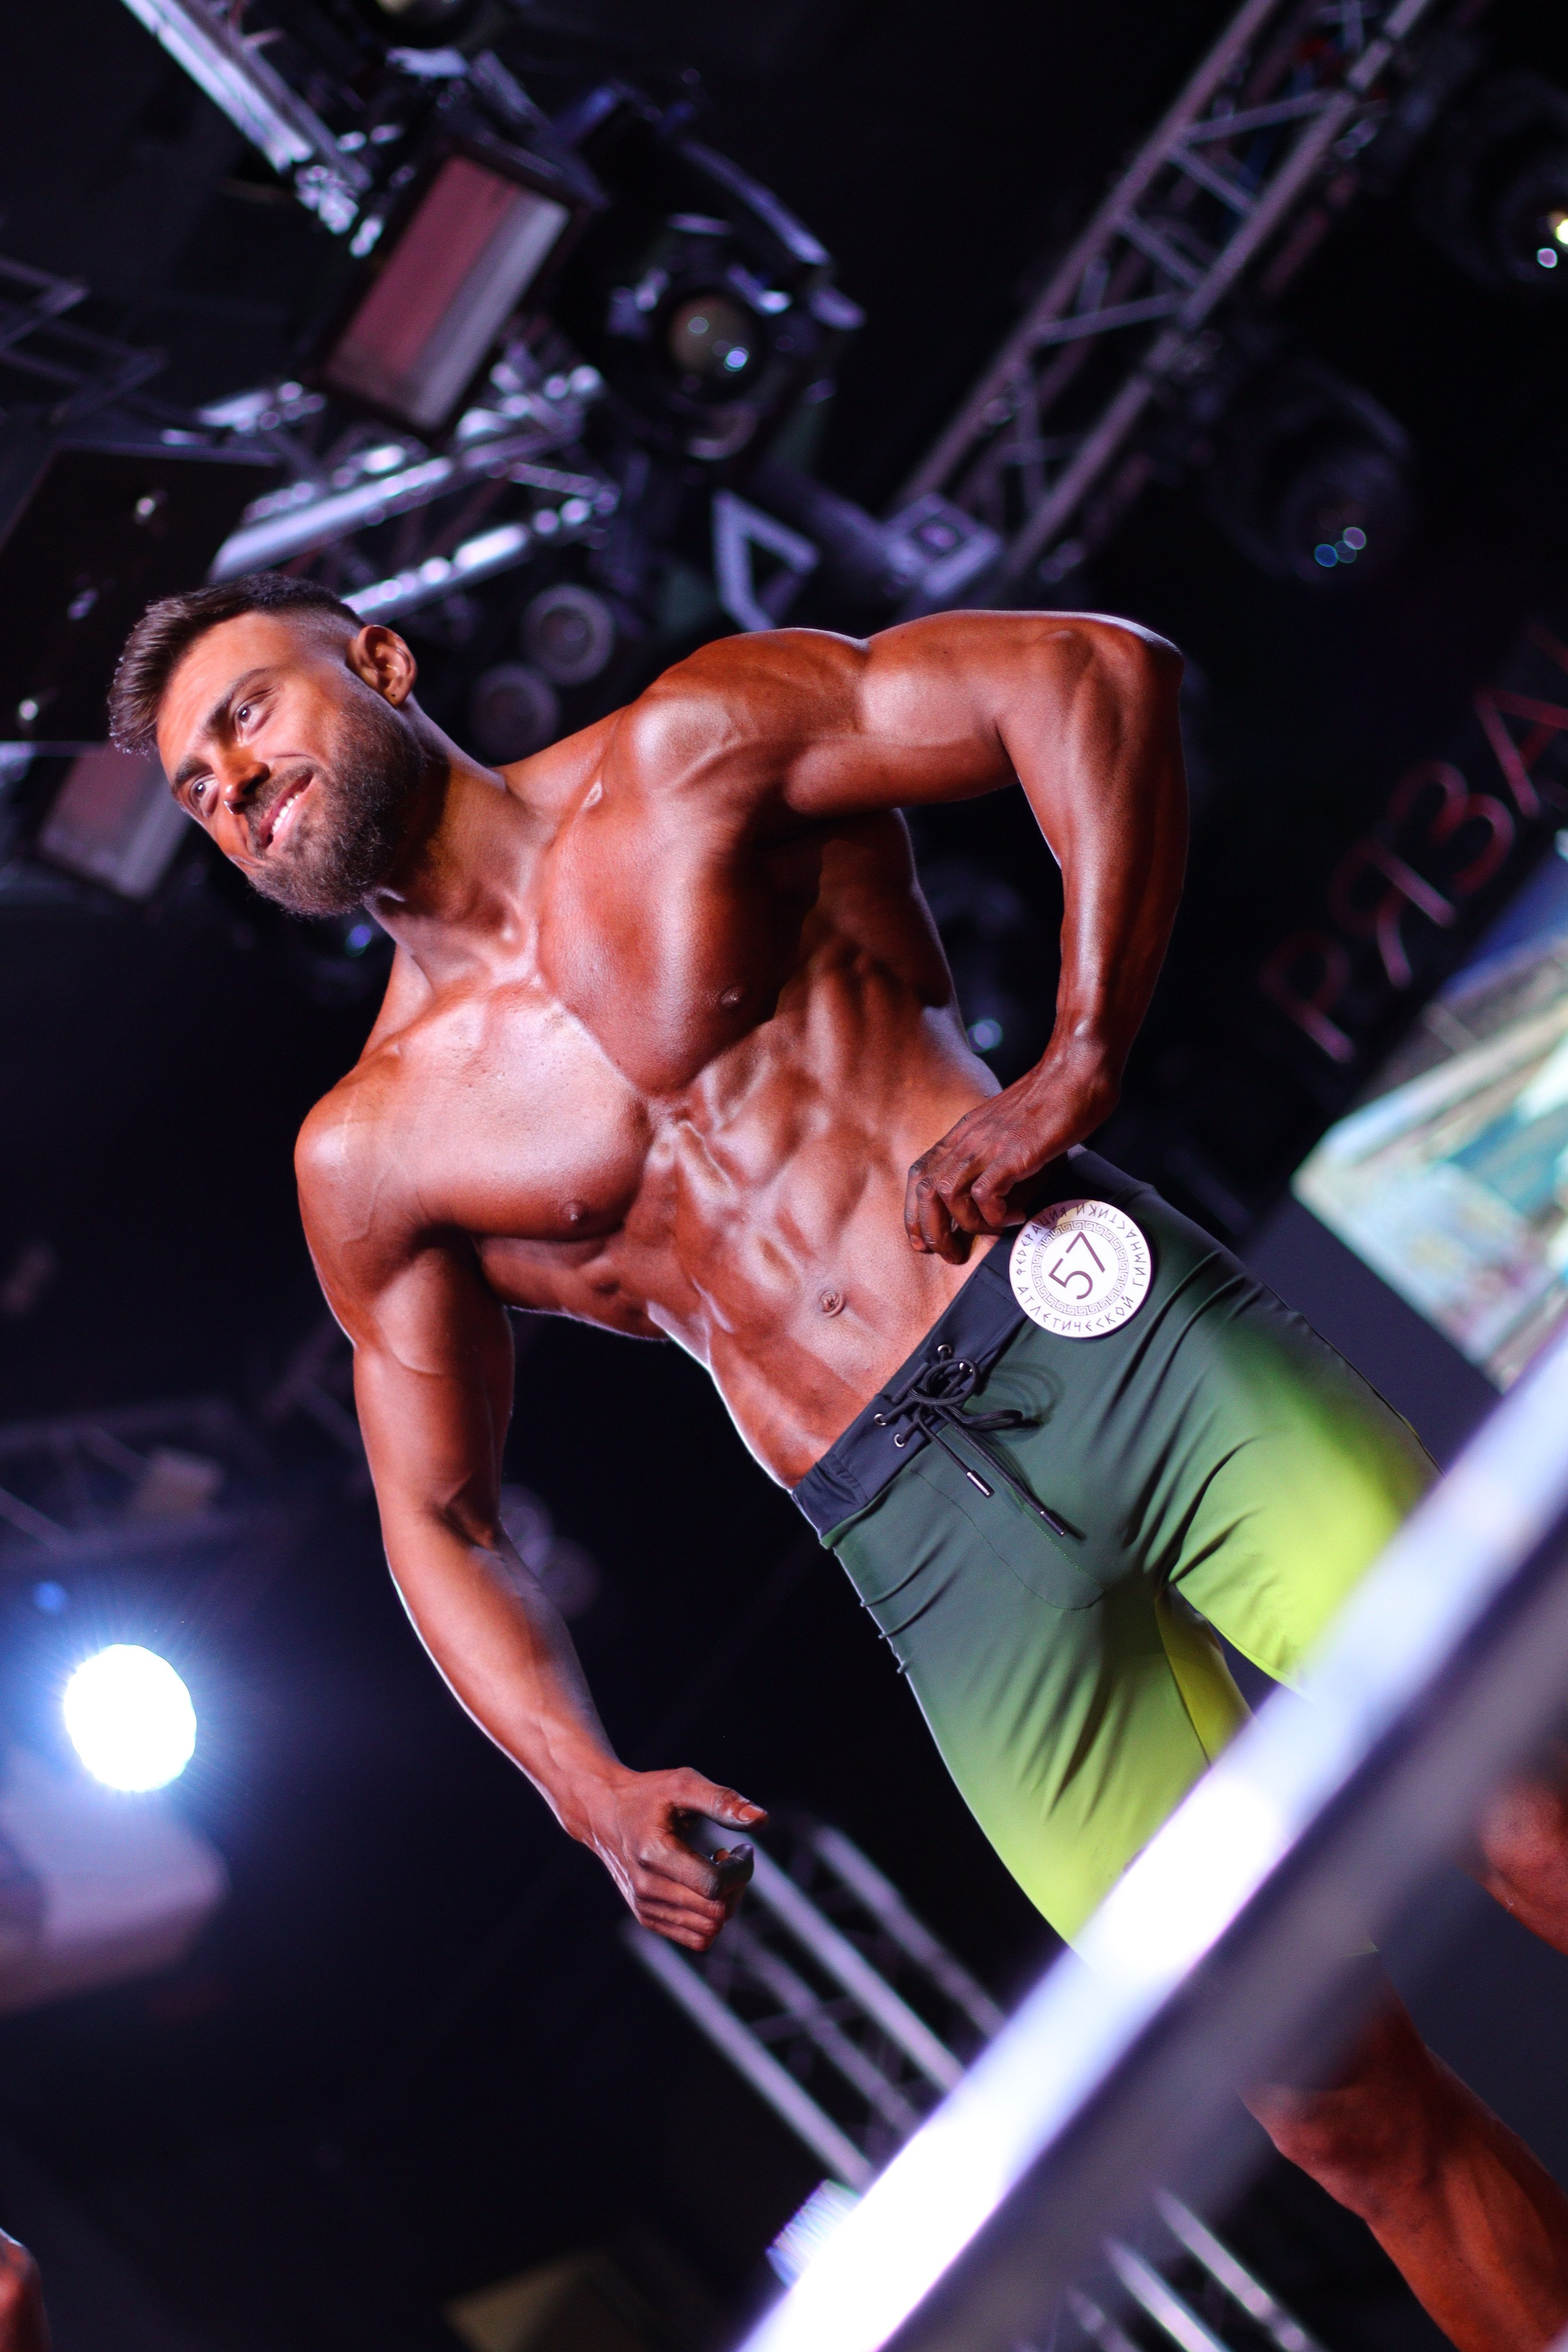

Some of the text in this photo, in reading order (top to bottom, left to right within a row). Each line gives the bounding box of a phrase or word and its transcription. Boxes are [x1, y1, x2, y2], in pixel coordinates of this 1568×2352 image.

[1257, 620, 1568, 1063] РЯЗА
[1016, 1204, 1147, 1332] ФЕДЕРАЦИЯ АТЛЕТИЧЕСКОЙ ГИМНАСТИКИ
[1048, 1231, 1106, 1300] 57
